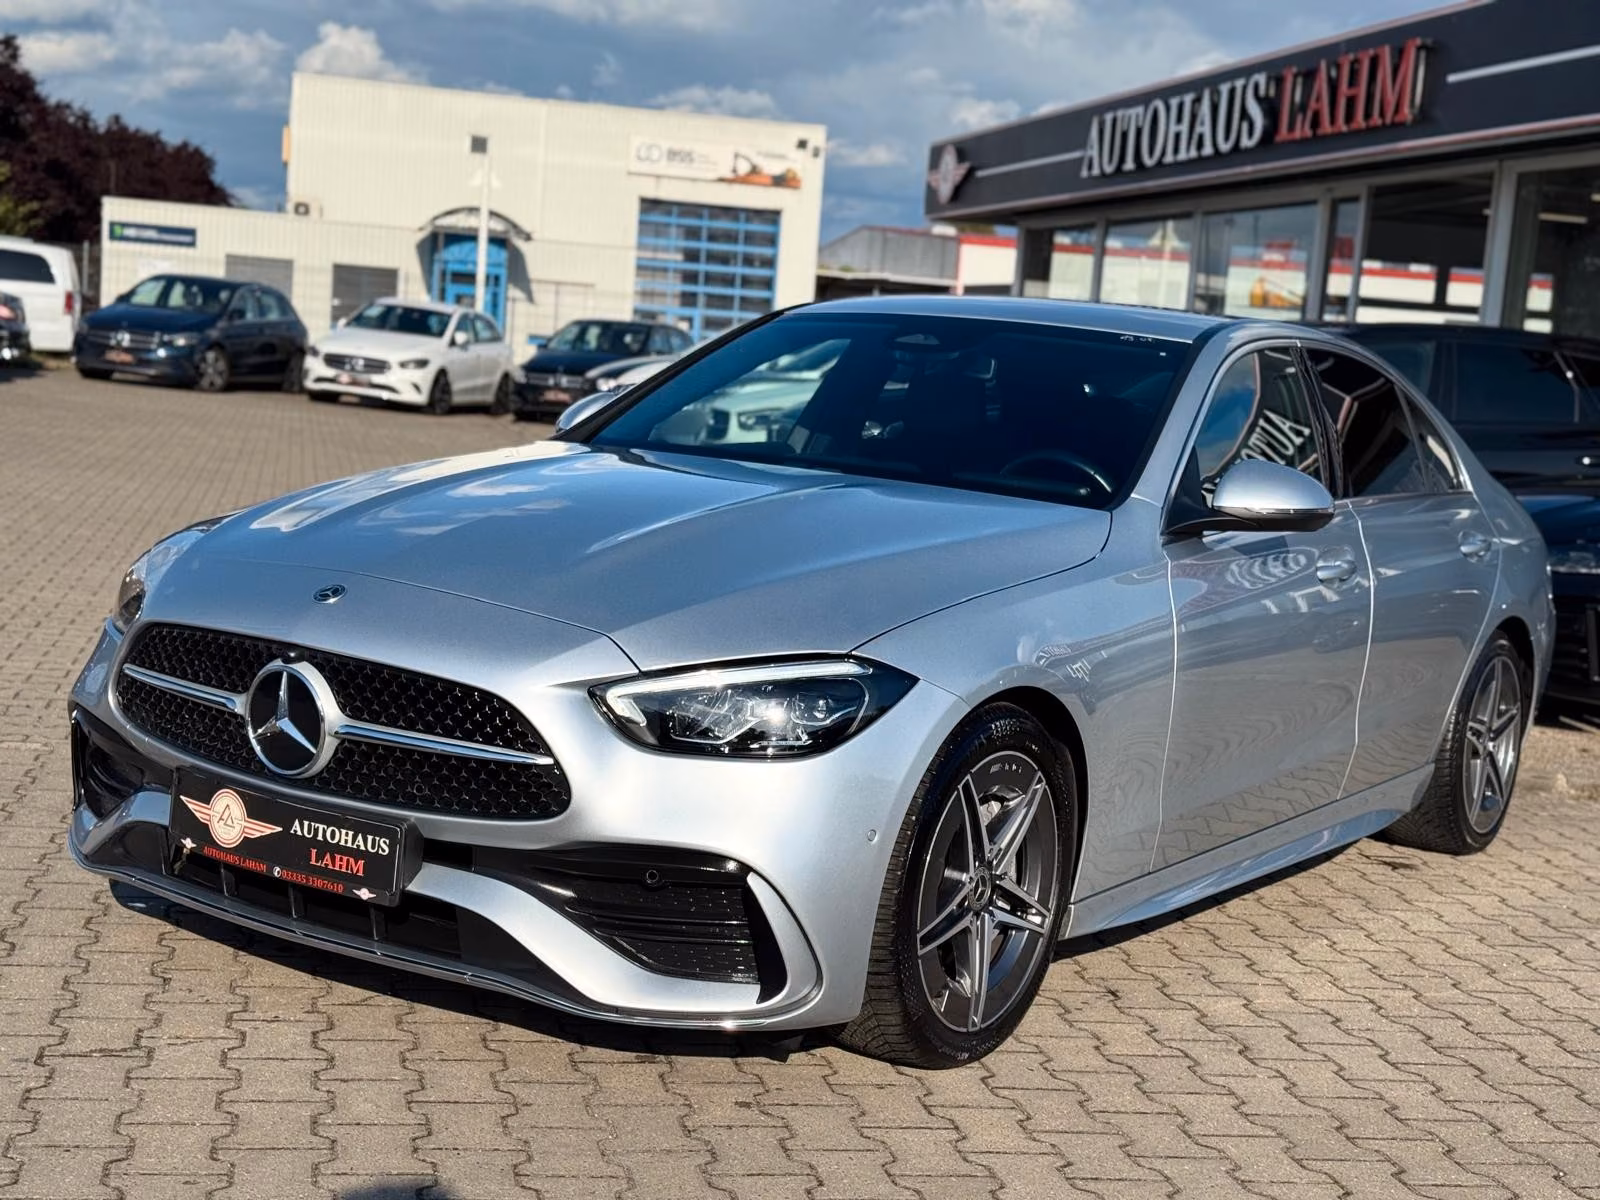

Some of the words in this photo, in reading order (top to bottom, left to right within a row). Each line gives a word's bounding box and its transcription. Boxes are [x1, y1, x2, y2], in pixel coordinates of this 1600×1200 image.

[1080, 72, 1267, 178] AUTOHAUS
[1274, 38, 1422, 142] LAHM
[290, 818, 390, 856] AUTOHAUS
[203, 846, 240, 865] AUTOHAUS
[240, 857, 267, 873] LAHAM
[281, 869, 306, 882] 03335
[307, 875, 344, 893] 3307610
[309, 847, 365, 876] LAHM
